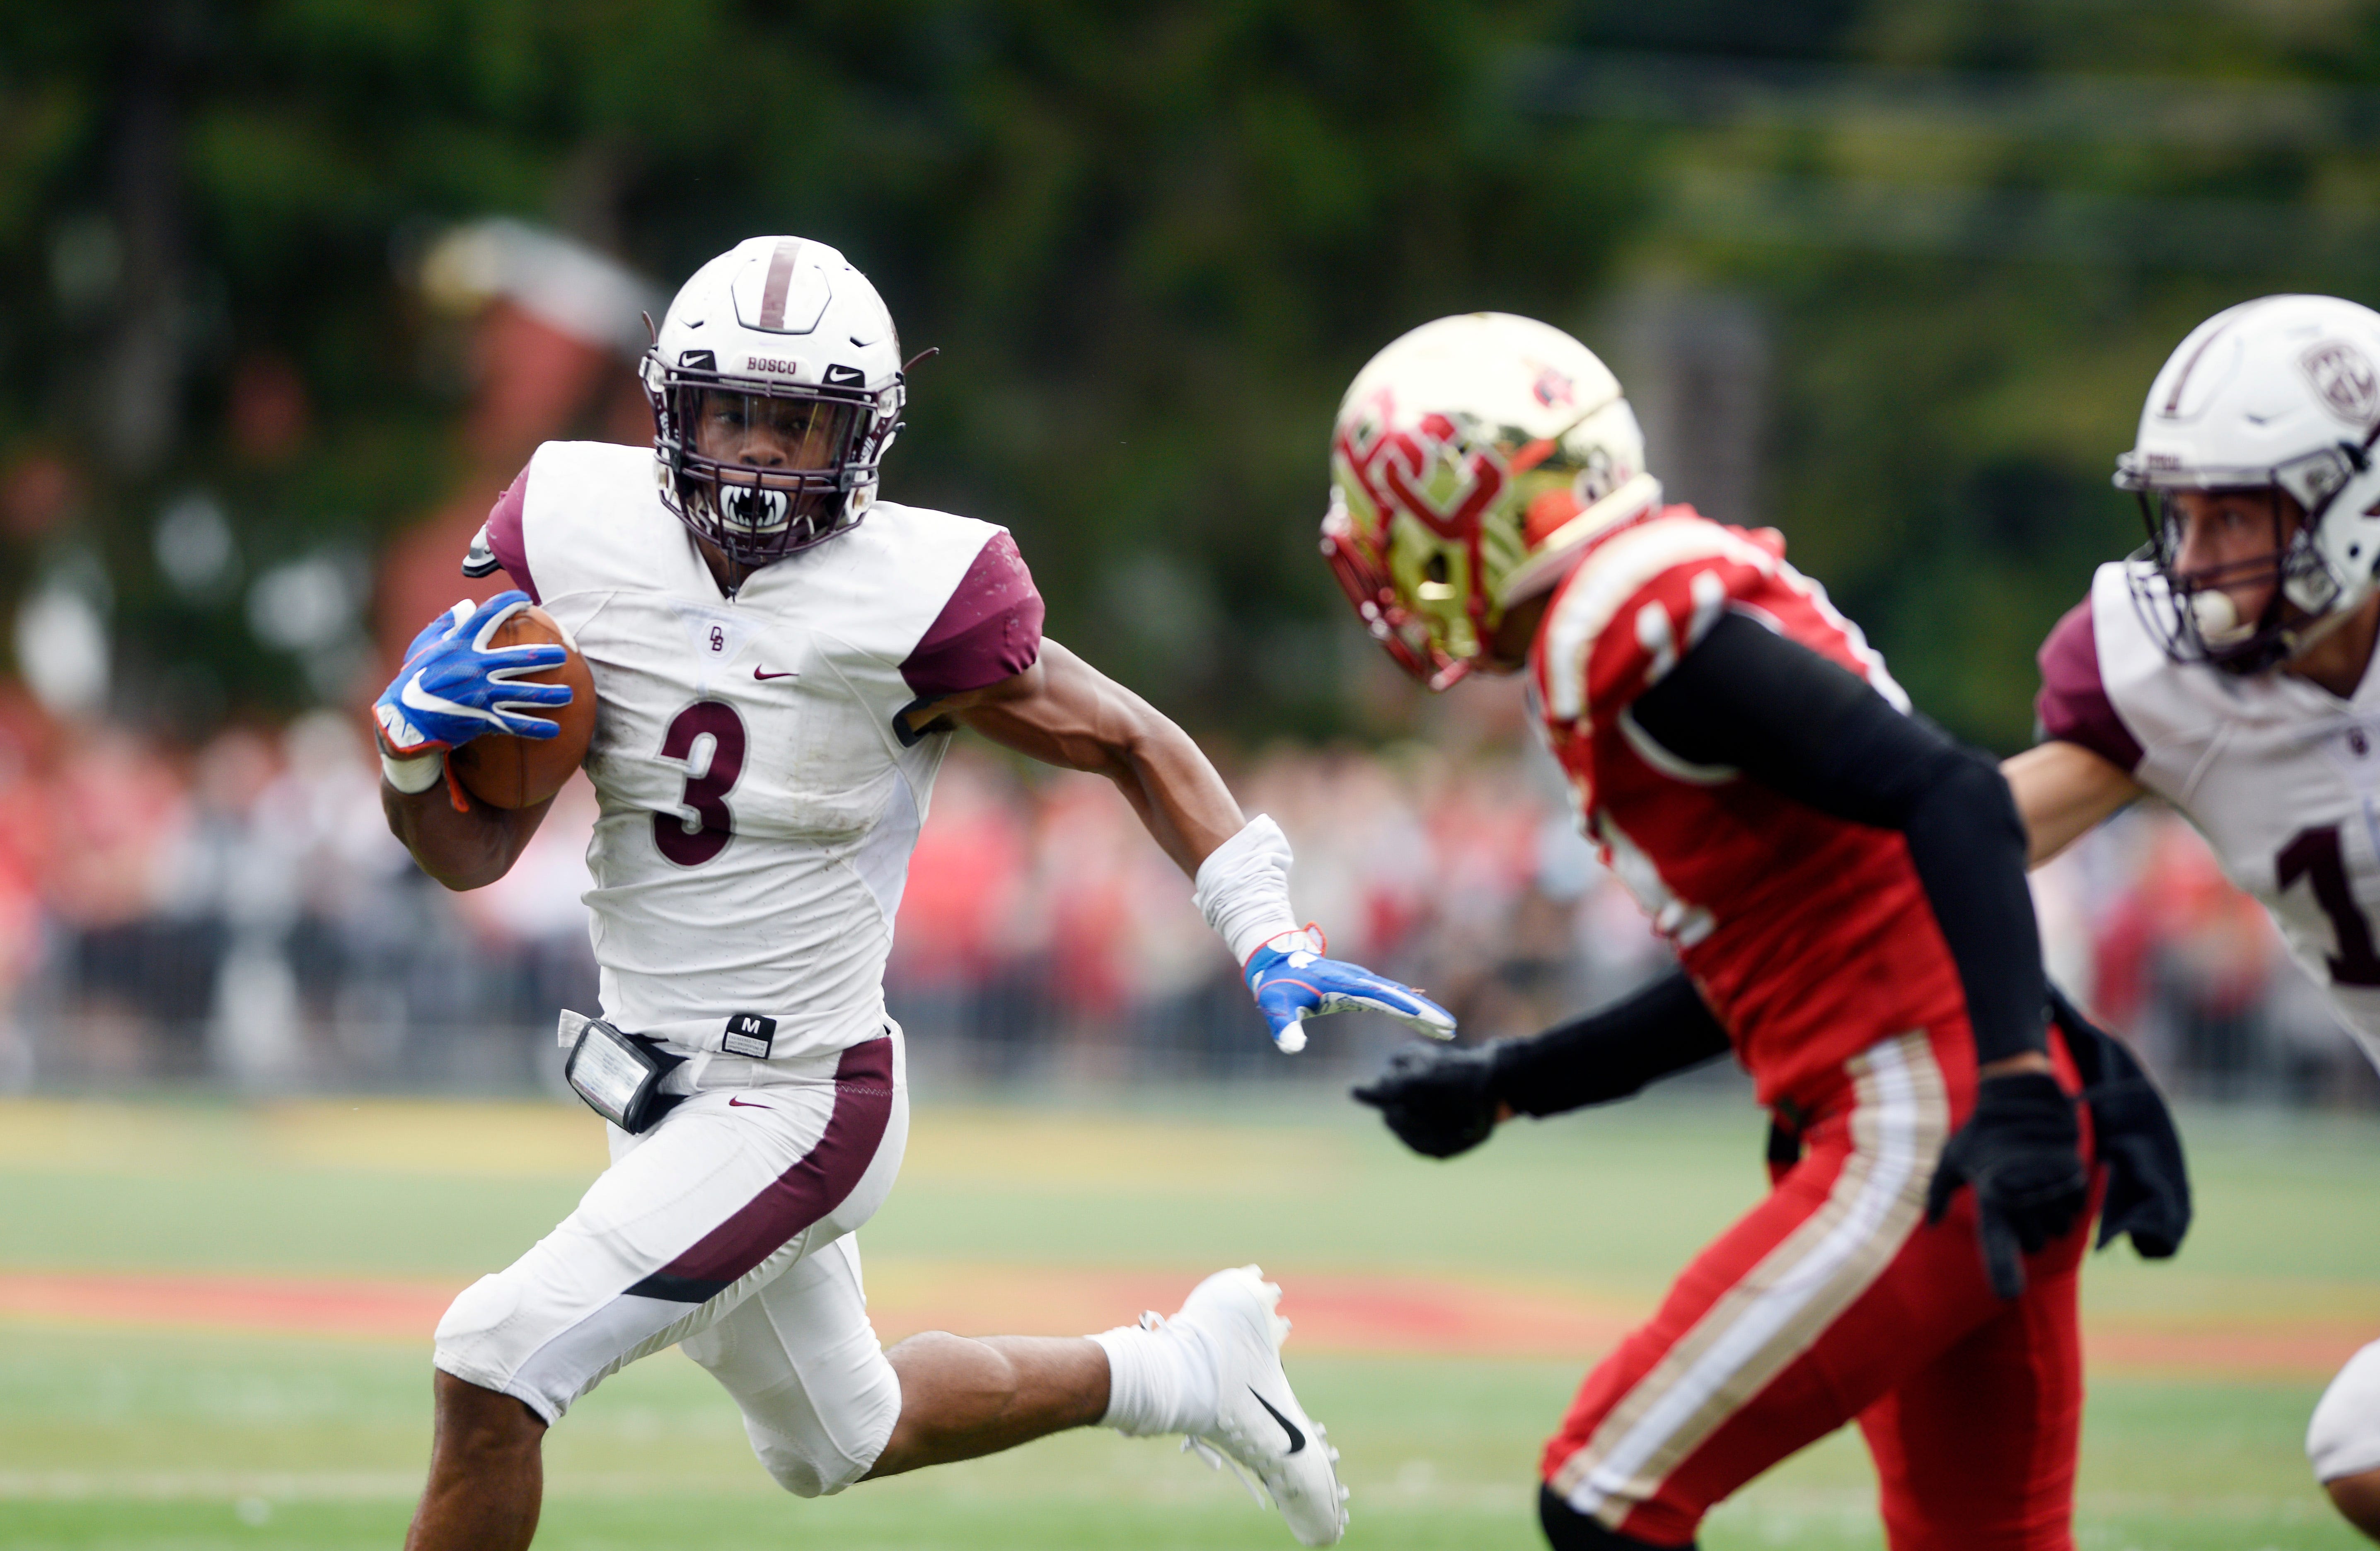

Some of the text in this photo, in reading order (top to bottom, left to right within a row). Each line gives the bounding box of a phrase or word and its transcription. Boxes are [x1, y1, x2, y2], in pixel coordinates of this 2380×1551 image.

[747, 357, 796, 374] BOSCO
[652, 698, 750, 869] 3
[741, 1017, 761, 1034] M
